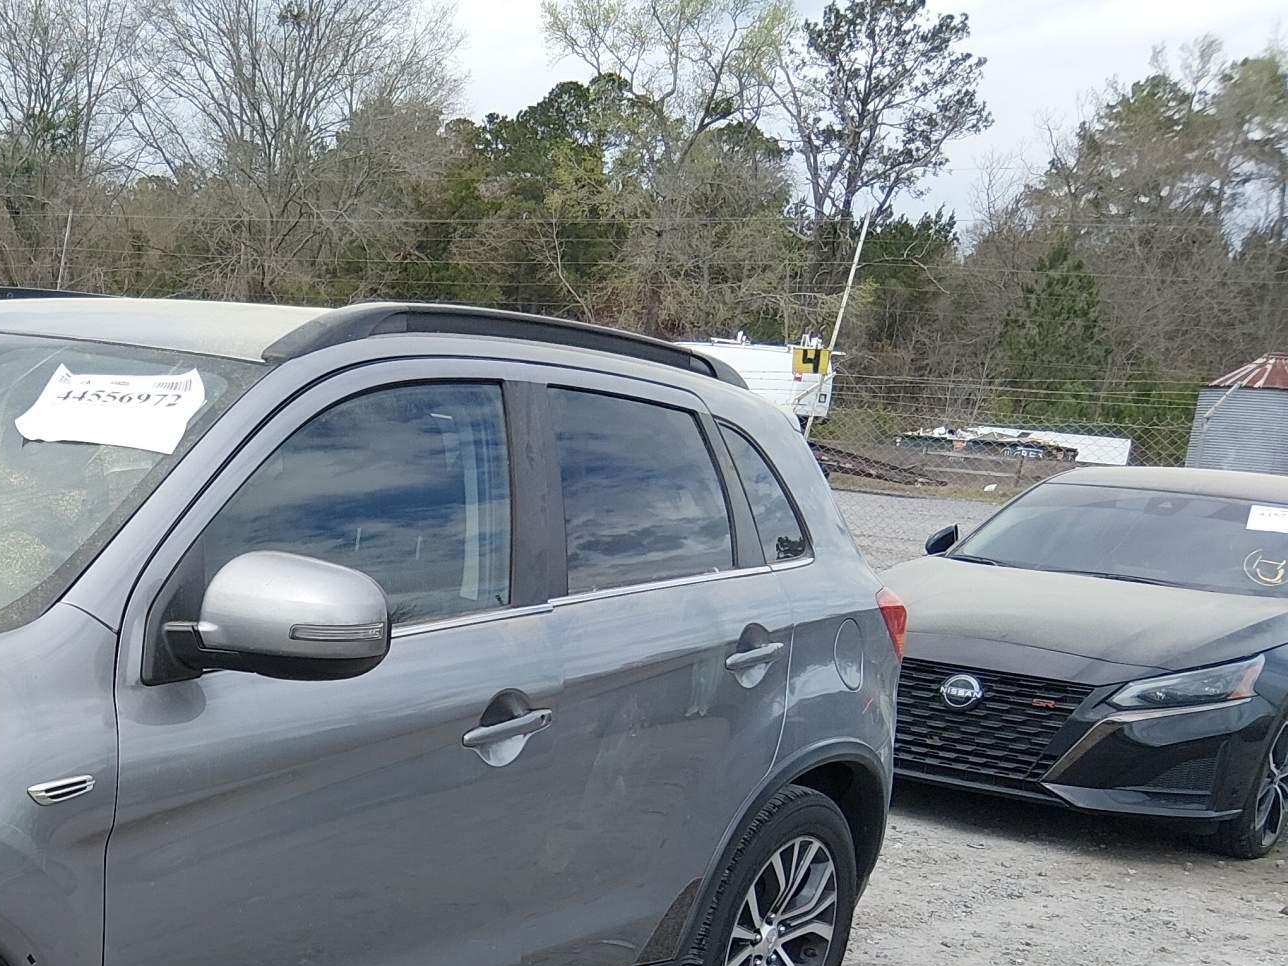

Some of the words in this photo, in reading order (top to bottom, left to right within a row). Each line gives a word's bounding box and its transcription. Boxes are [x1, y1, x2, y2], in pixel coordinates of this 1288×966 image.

[802, 349, 821, 373] 4
[56, 390, 182, 408] 44556972
[939, 686, 983, 698] NISSAN
